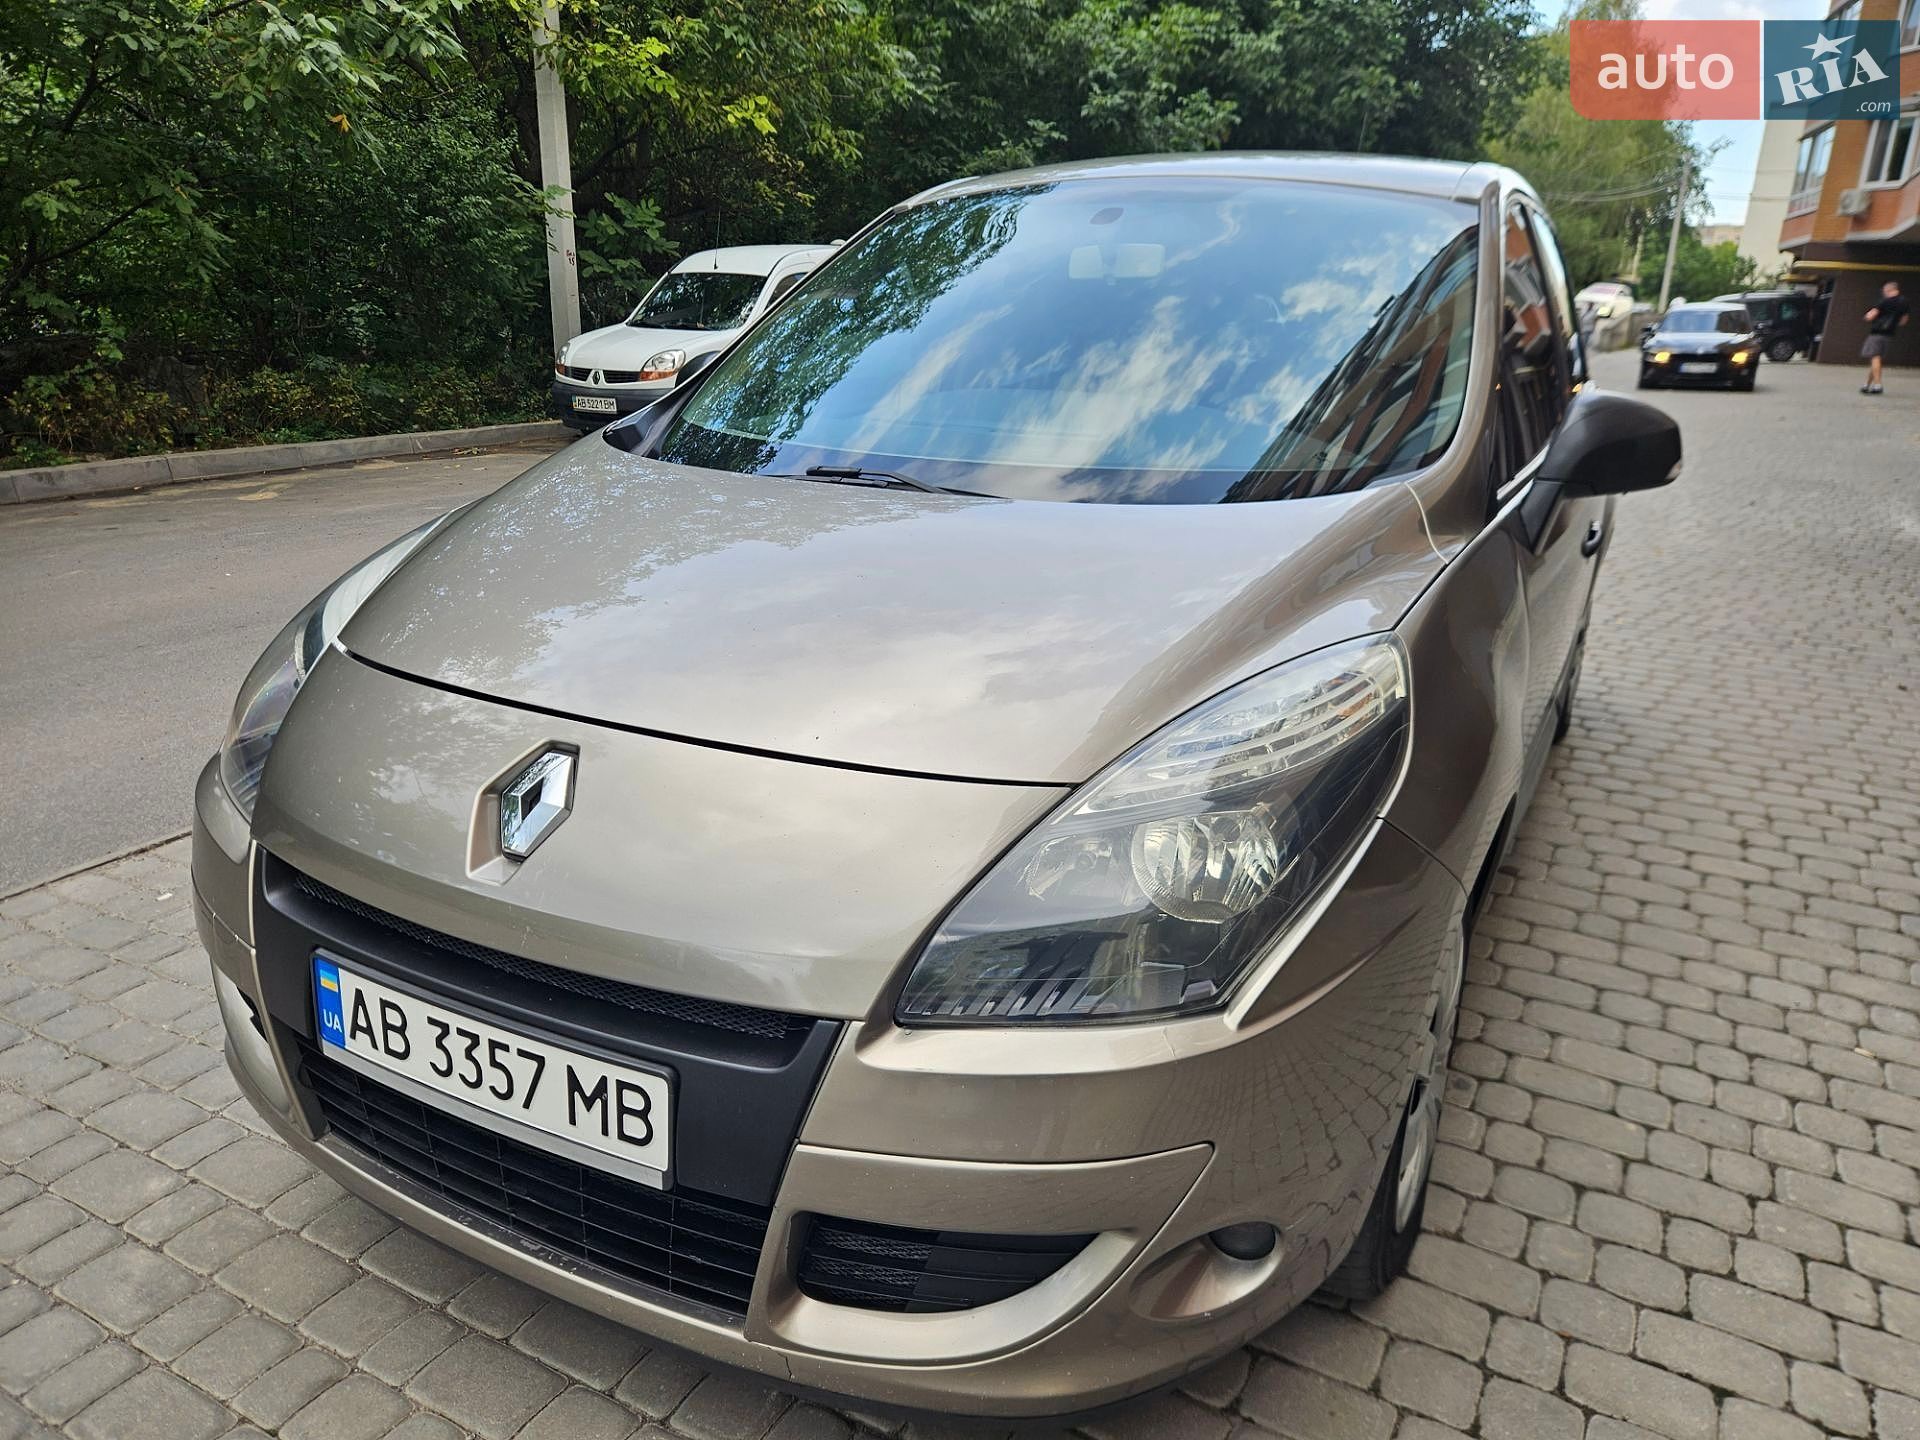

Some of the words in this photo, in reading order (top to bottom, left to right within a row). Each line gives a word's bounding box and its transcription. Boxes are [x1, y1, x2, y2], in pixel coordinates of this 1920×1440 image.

[322, 1008, 342, 1033] UA
[349, 987, 411, 1061] AB
[426, 1015, 546, 1110] 3357
[566, 1063, 654, 1147] MB
